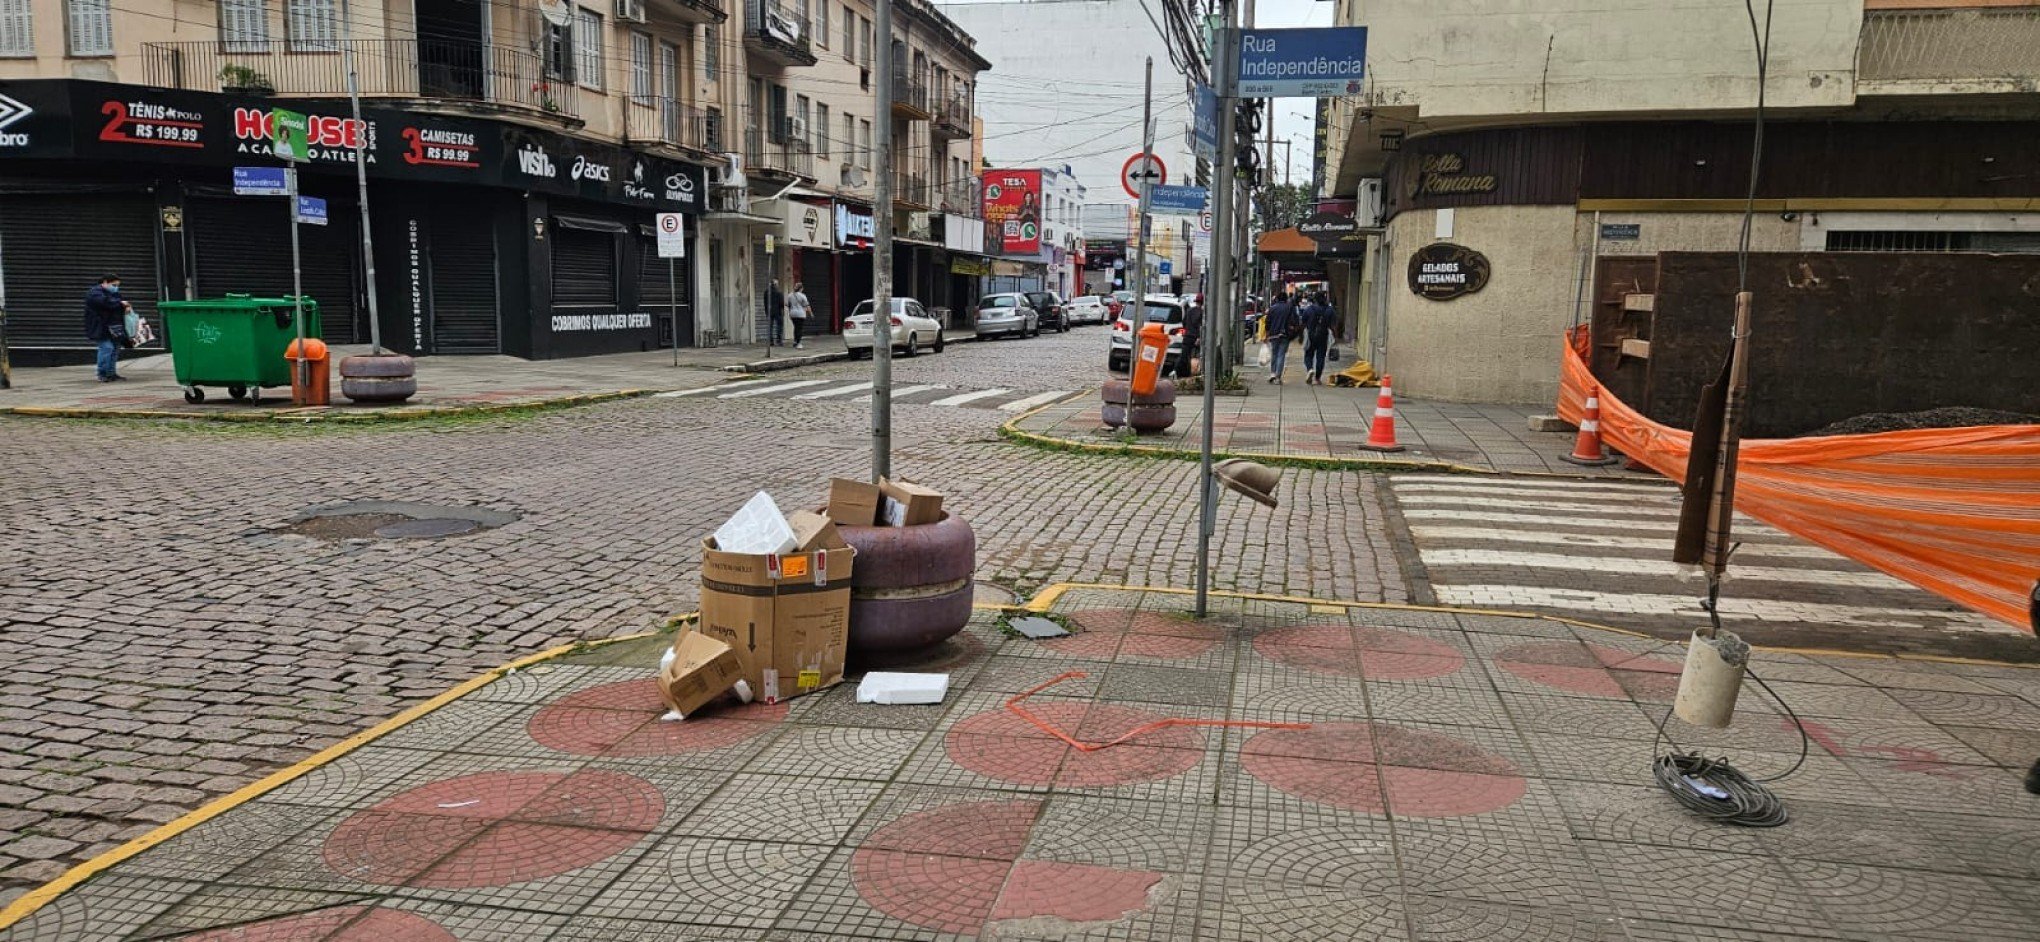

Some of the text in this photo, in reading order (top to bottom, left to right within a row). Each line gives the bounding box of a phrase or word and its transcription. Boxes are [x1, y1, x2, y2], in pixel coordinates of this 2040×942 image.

[1243, 35, 1276, 53] Rua
[1242, 57, 1362, 79] Independência
[128, 102, 202, 121] TÊNIS POLO
[99, 101, 126, 141] 2
[0, 130, 28, 146] bro
[136, 124, 198, 142] R$ 199.99
[420, 129, 475, 146] CAMISETAS
[402, 127, 423, 165] 3
[427, 147, 469, 161] R$ 99.99
[1421, 173, 1495, 194] Romana
[666, 218, 675, 230] E
[1422, 263, 1459, 273] GELADOS
[1417, 274, 1466, 284] ARTESANAIS
[551, 313, 651, 332] COBRIMOS QUALQUER OFERTA
